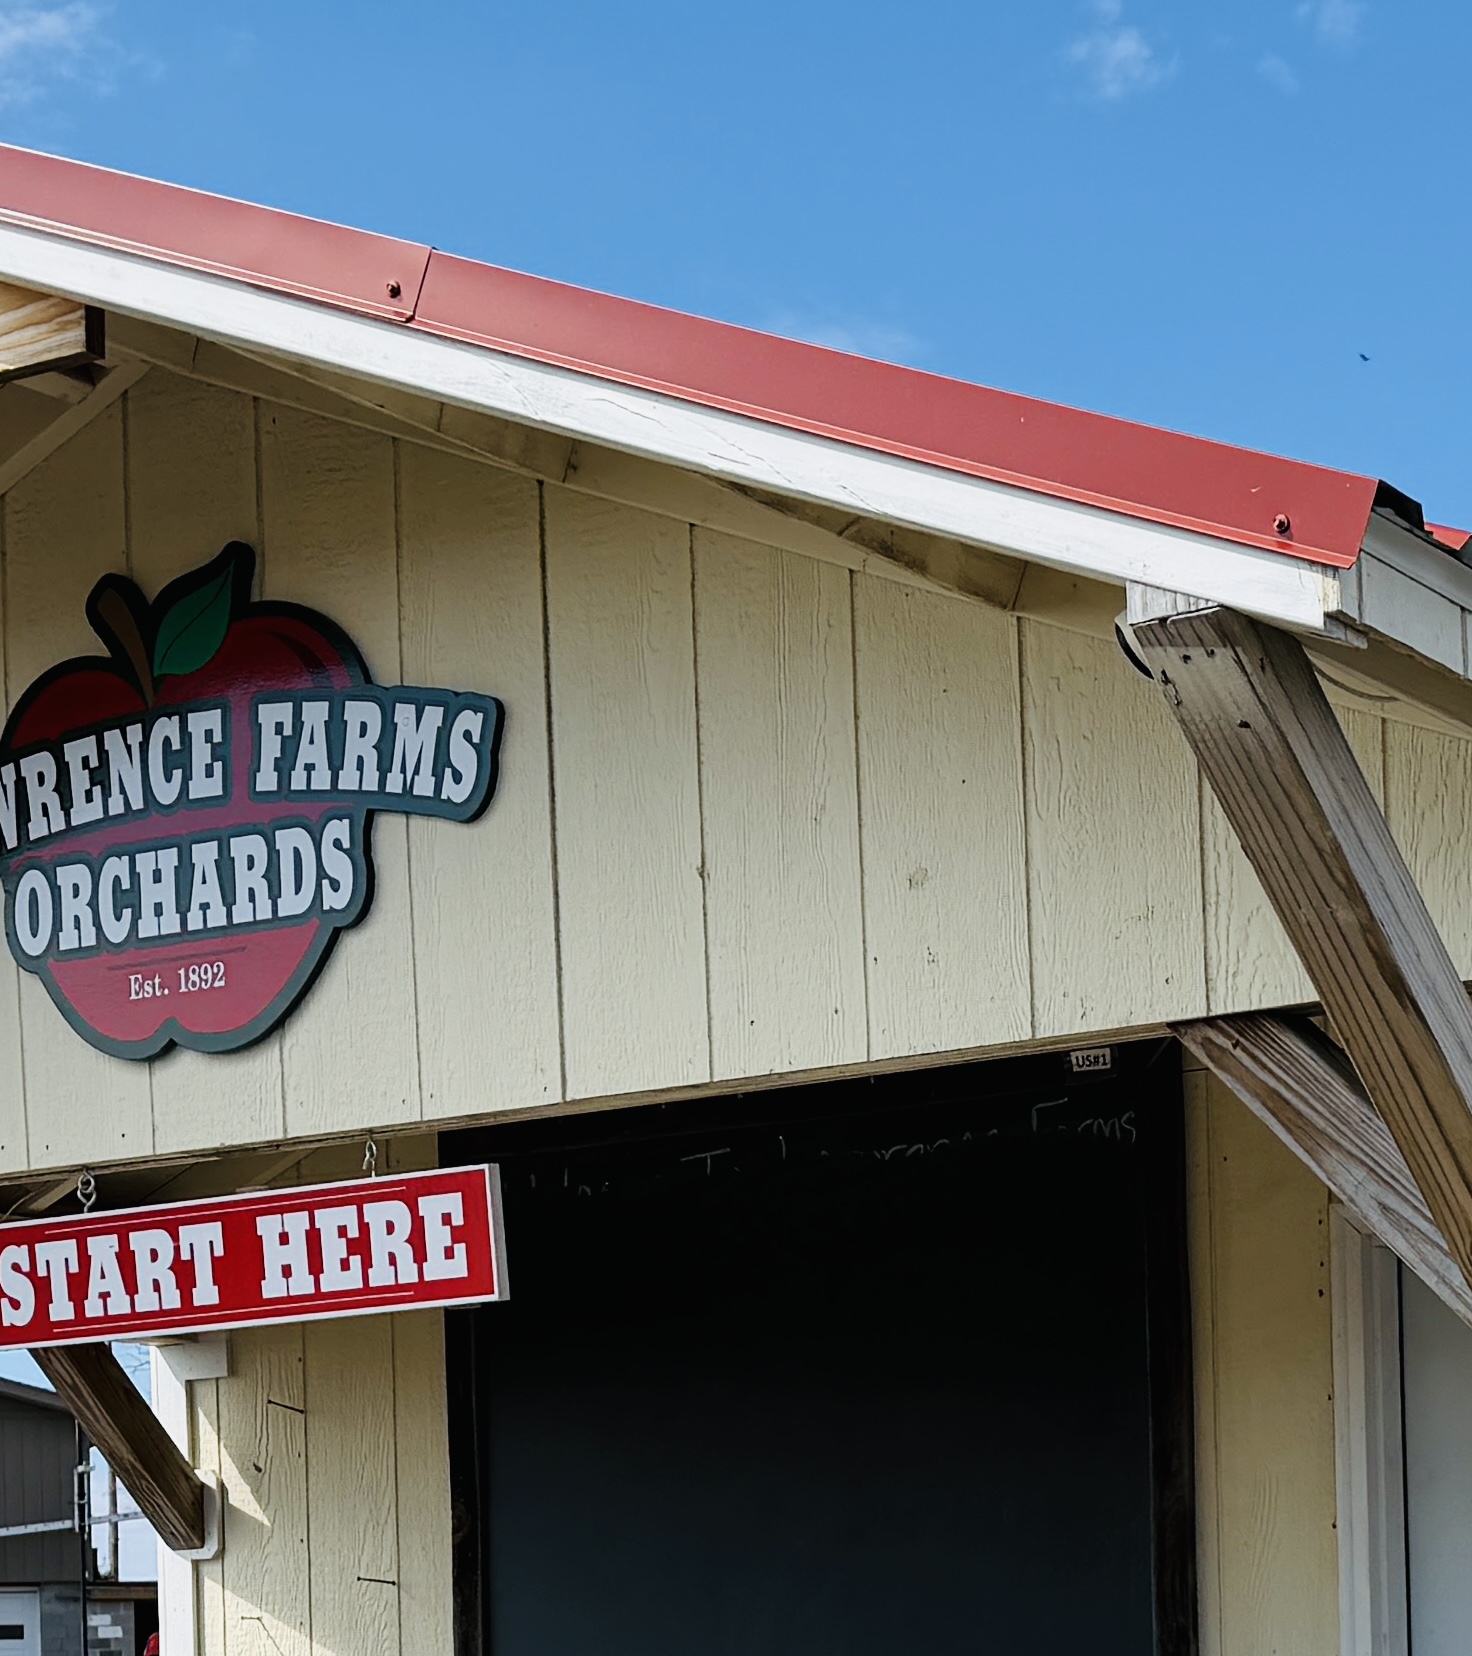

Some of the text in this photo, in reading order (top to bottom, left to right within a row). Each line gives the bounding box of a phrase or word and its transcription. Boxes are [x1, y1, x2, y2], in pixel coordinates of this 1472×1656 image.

[254, 699, 484, 804] FARMS
[13, 817, 356, 957] ORCHARDS
[128, 961, 227, 1001] Est. 1892
[1074, 1053, 1108, 1069] US#1
[255, 1191, 469, 1300] HERE
